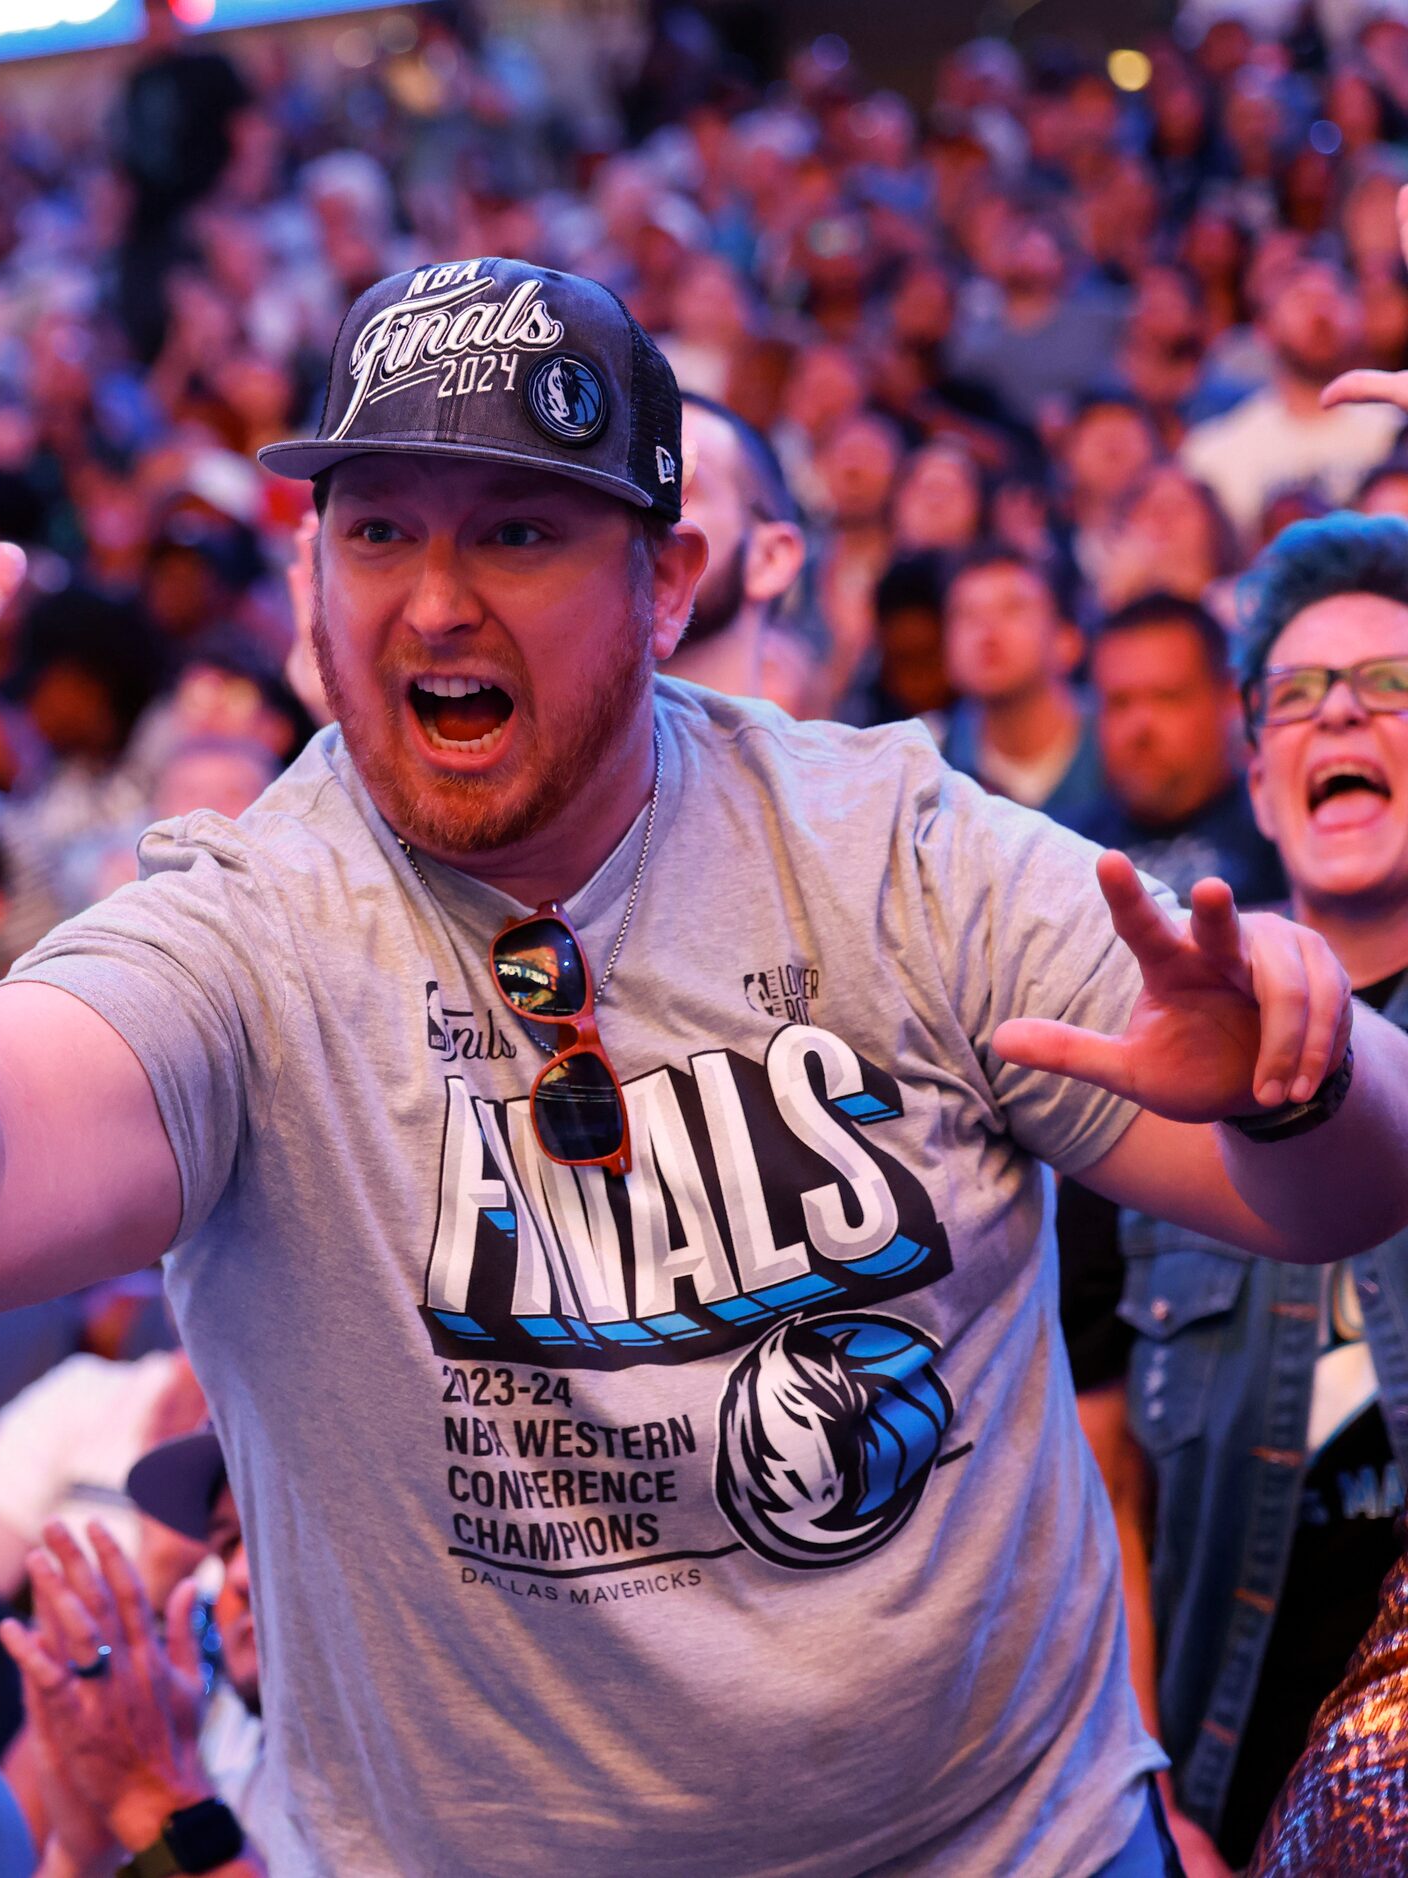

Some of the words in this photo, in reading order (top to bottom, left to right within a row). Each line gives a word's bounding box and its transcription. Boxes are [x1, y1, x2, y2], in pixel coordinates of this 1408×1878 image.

[401, 261, 482, 301] NBA
[327, 276, 565, 440] Finals
[437, 353, 520, 399] 2024
[425, 1023, 899, 1325] FINALS
[444, 1416, 510, 1457] NBA
[514, 1414, 696, 1460] WESTERN
[448, 1465, 678, 1510] CONFERENCE
[452, 1512, 660, 1562] CHAMPIONS
[461, 1566, 559, 1600] DALLAS
[569, 1568, 702, 1605] MAVERICKS
